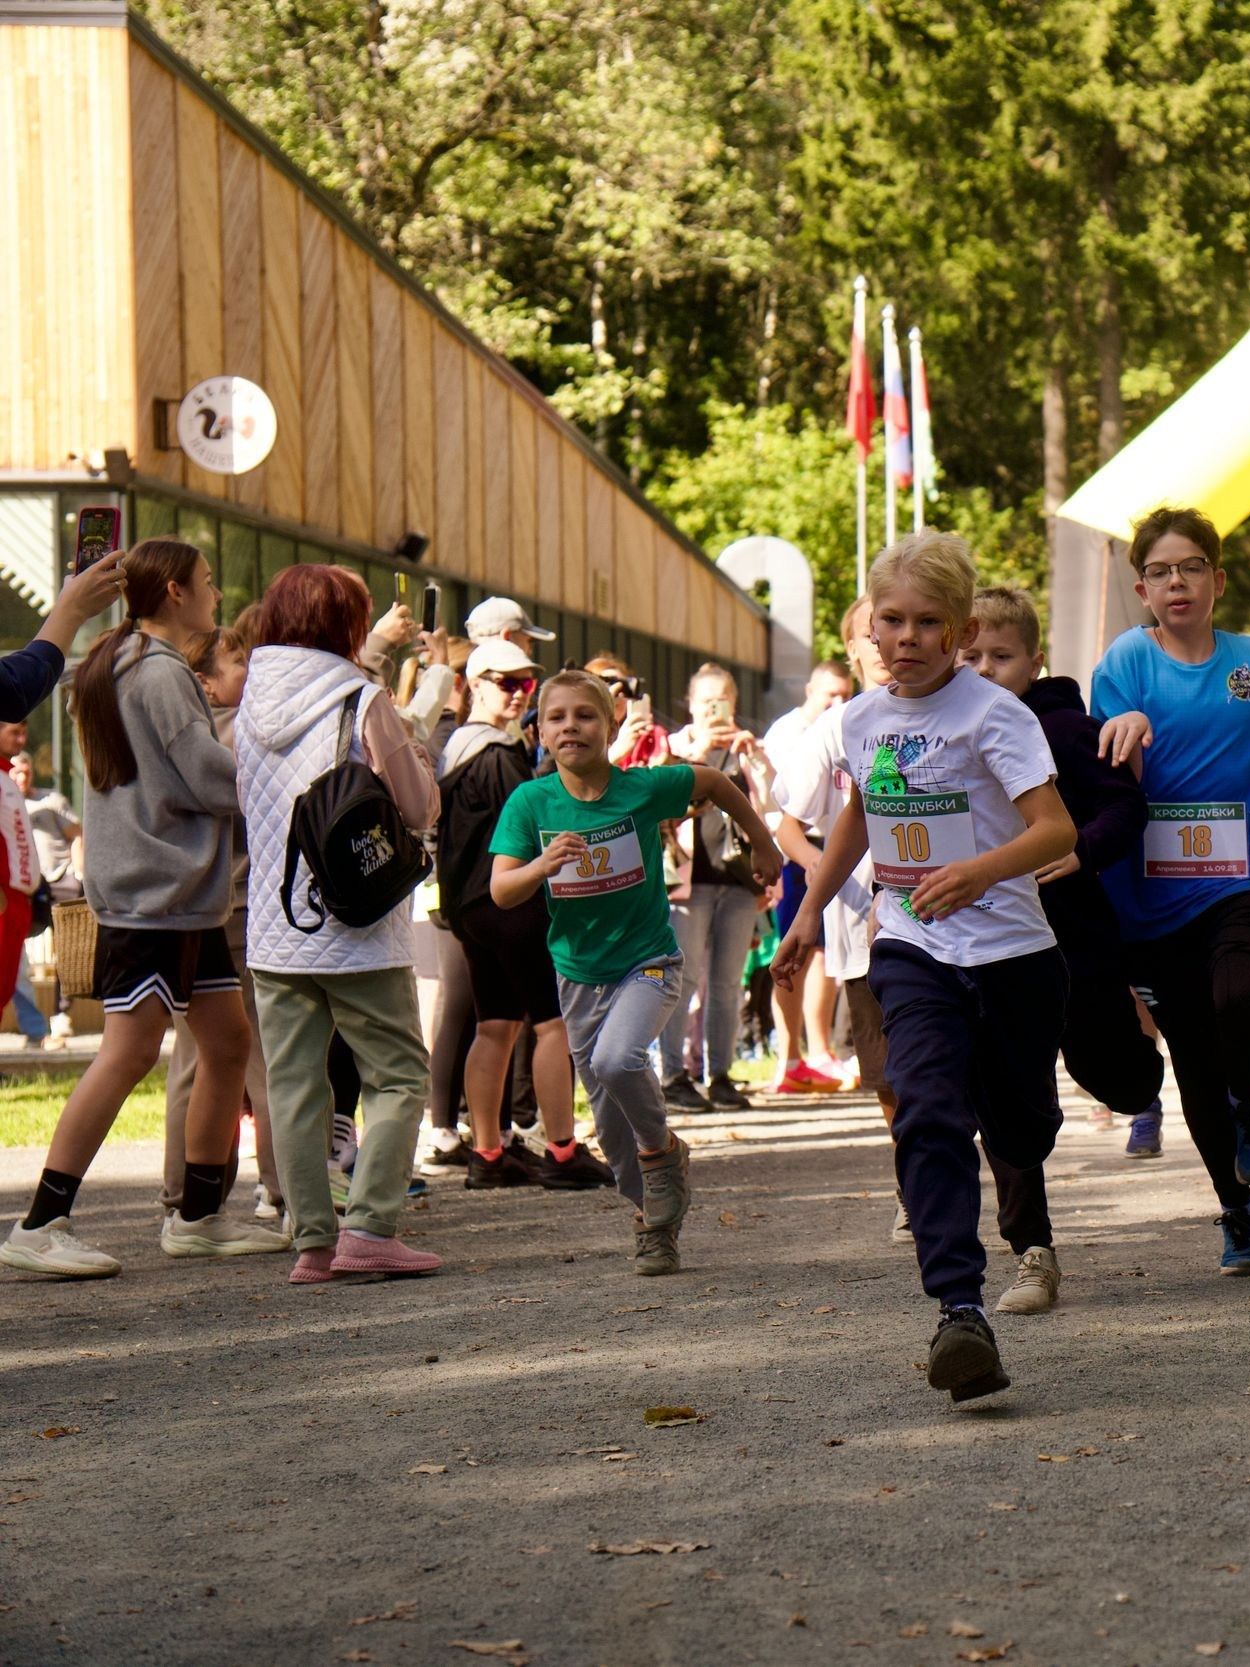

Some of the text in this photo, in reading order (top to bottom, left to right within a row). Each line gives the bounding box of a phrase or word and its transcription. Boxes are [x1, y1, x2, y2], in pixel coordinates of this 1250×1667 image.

[870, 798, 957, 814] КРОСС ДУБКИ
[1154, 807, 1236, 819] КРОСС ДУБКИ
[590, 824, 627, 843] ДУБКИ
[890, 822, 931, 863] 10
[1177, 825, 1212, 858] 18
[576, 847, 614, 879] 32
[1155, 864, 1238, 873] Апрелевка 14.09.25
